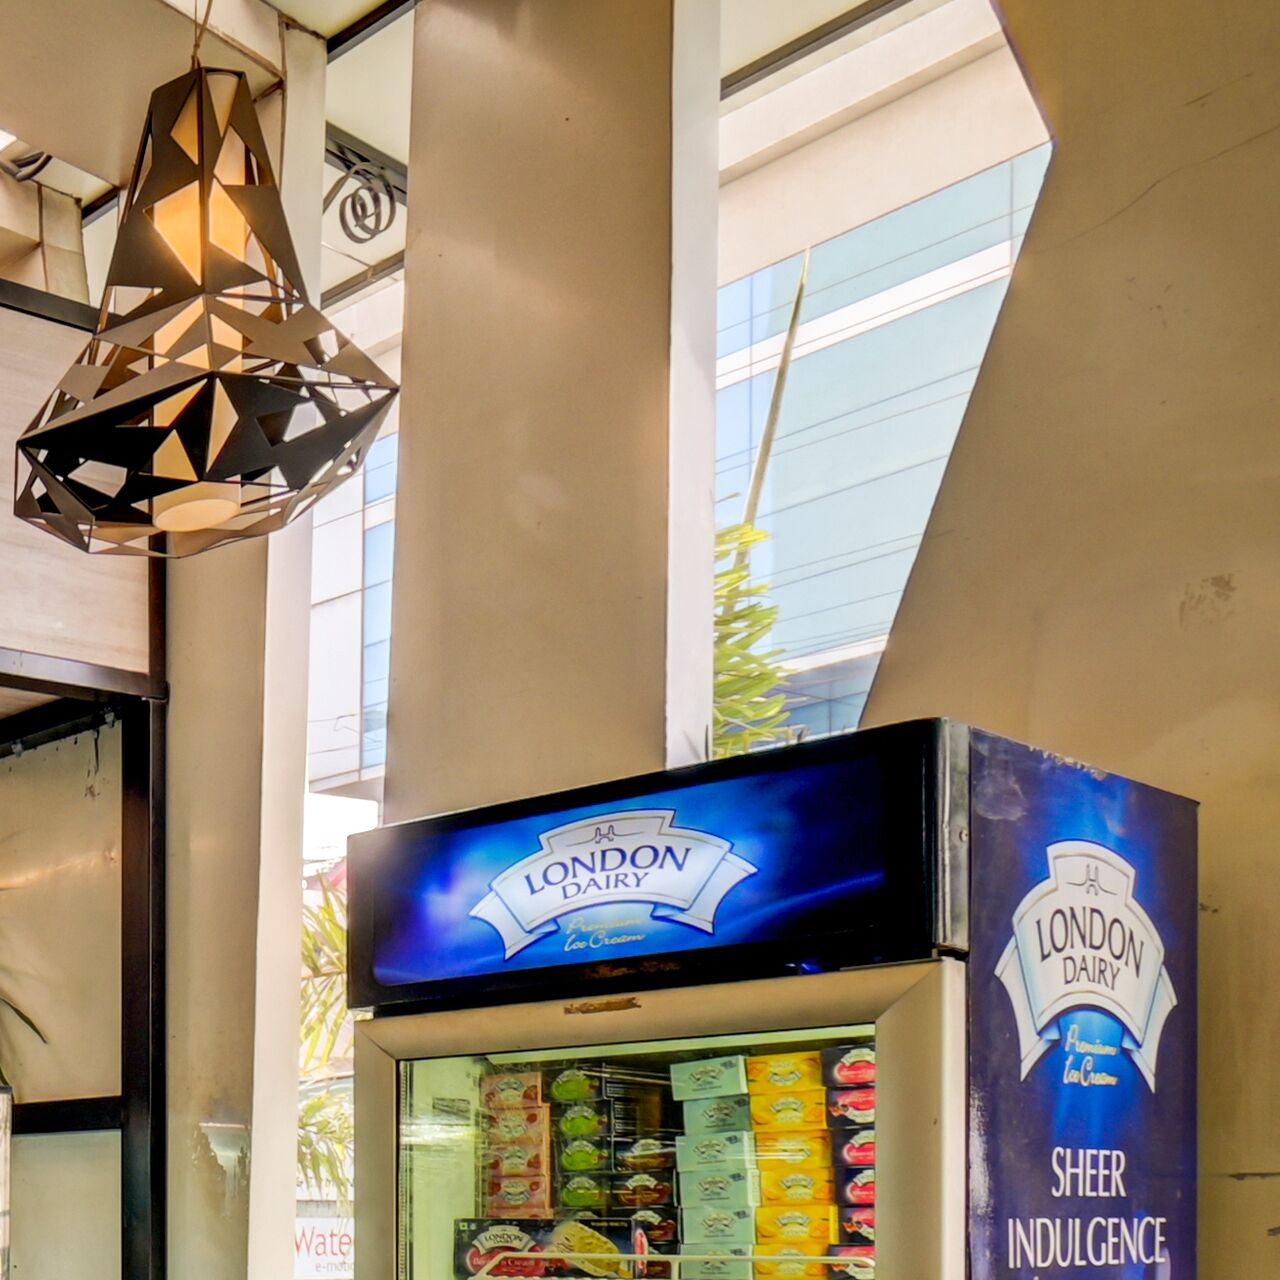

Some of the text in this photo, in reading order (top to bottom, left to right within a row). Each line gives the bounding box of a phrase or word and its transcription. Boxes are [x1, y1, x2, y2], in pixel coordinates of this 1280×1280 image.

[524, 844, 691, 895] LONDON
[561, 872, 649, 899] DAIRY
[589, 931, 646, 948] Cream
[1035, 905, 1144, 979] LONDON
[1062, 954, 1121, 991] DAIRY
[1050, 1146, 1127, 1198] SHEER
[484, 1232, 523, 1244] LONDON
[1007, 1215, 1167, 1269] INDULGENCE
